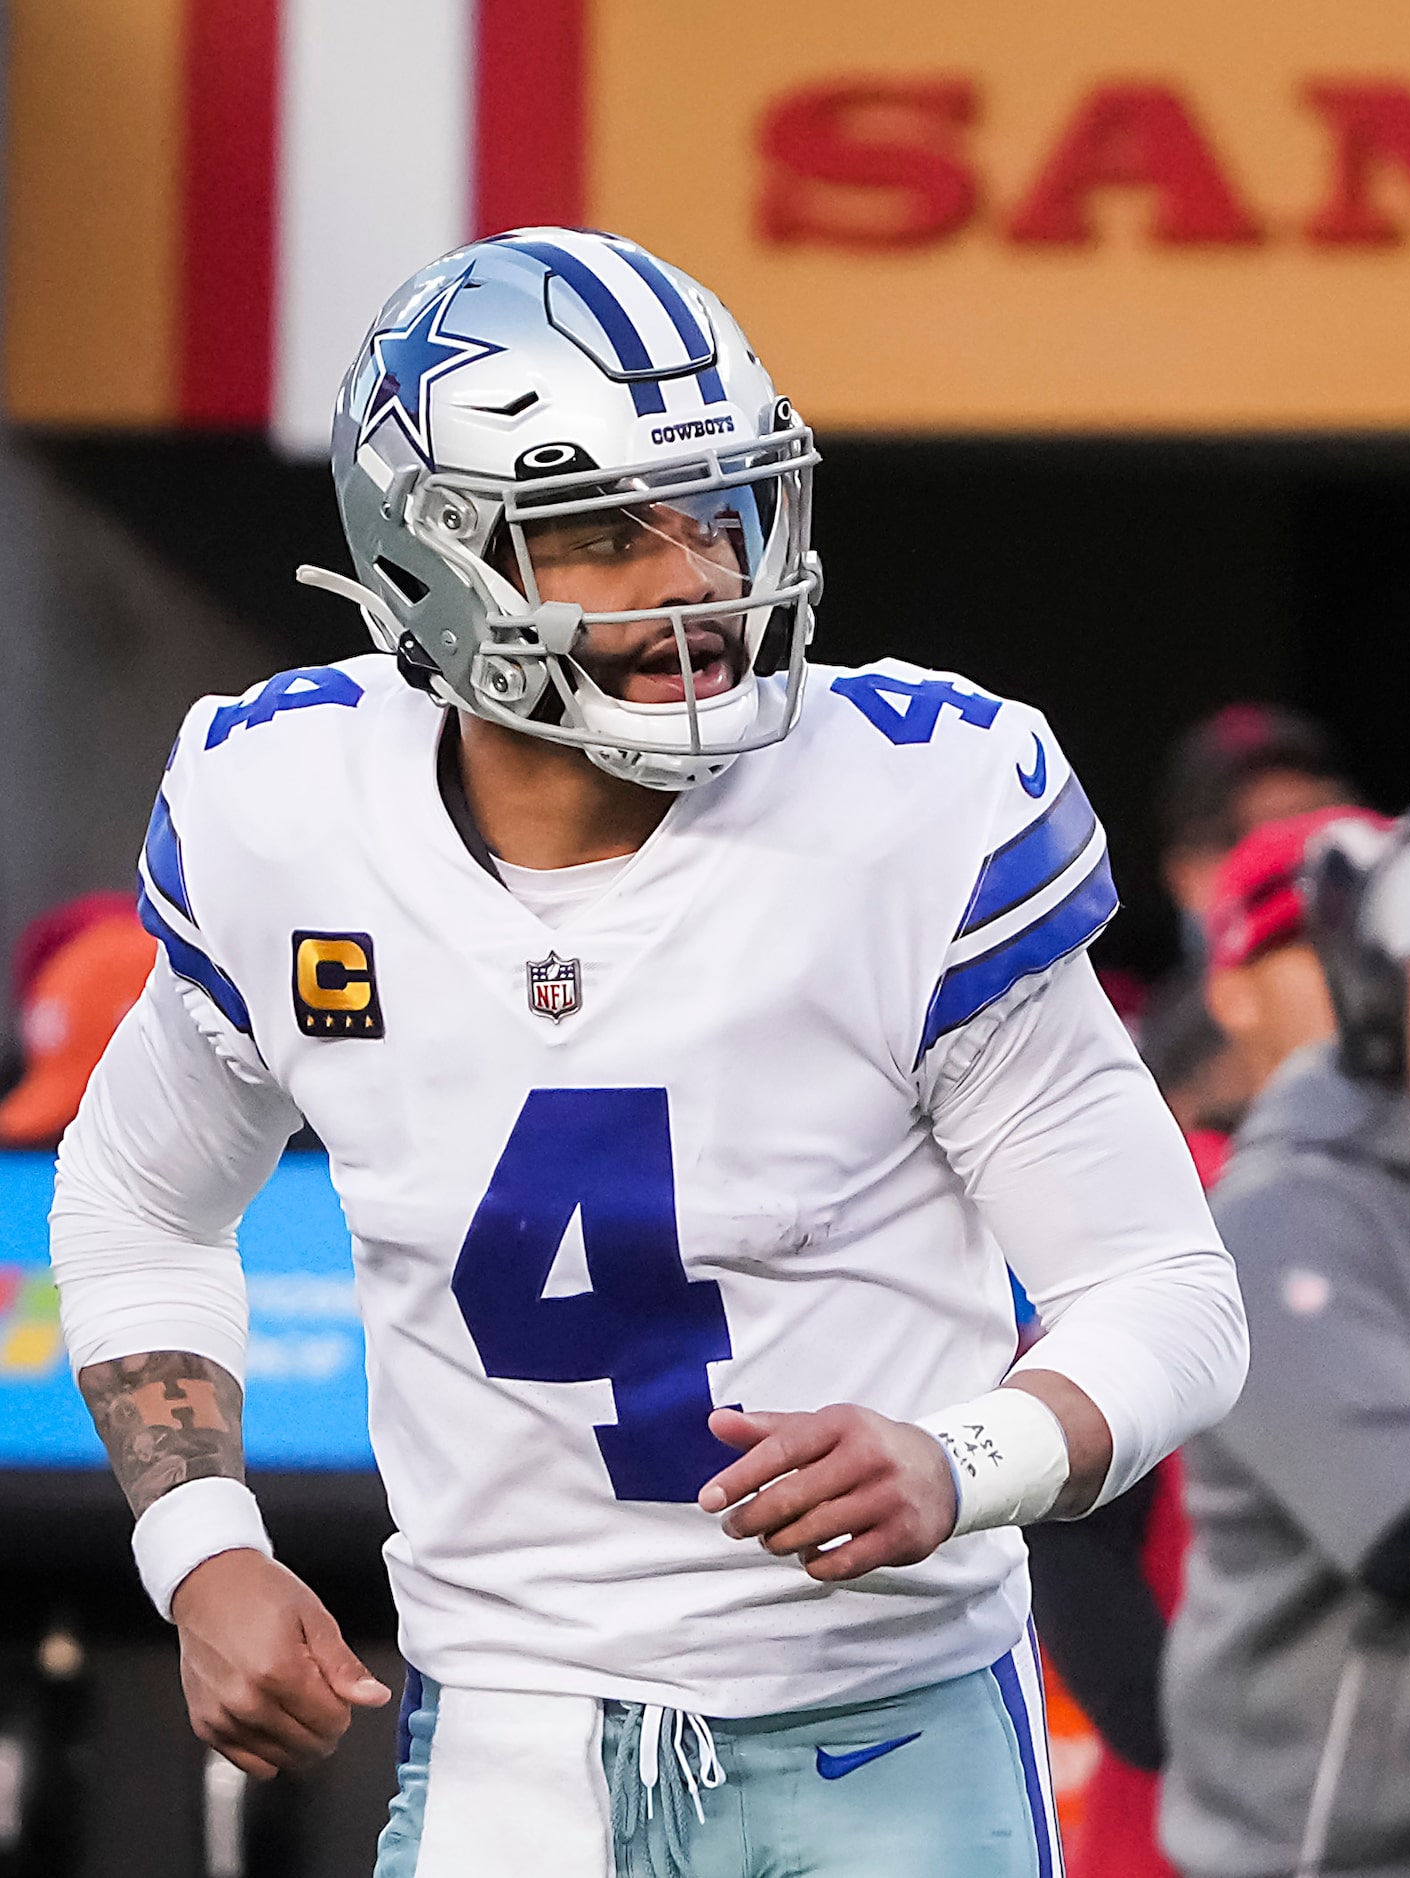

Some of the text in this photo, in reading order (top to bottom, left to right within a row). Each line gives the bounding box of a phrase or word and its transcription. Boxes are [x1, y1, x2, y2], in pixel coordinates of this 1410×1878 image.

[651, 415, 735, 445] COWBOYS
[204, 667, 365, 751] 4
[830, 673, 1003, 746] 4
[297, 938, 372, 1011] C
[536, 980, 574, 1011] NFL
[451, 1087, 744, 1503] 4
[962, 1424, 1004, 1468] ASK
